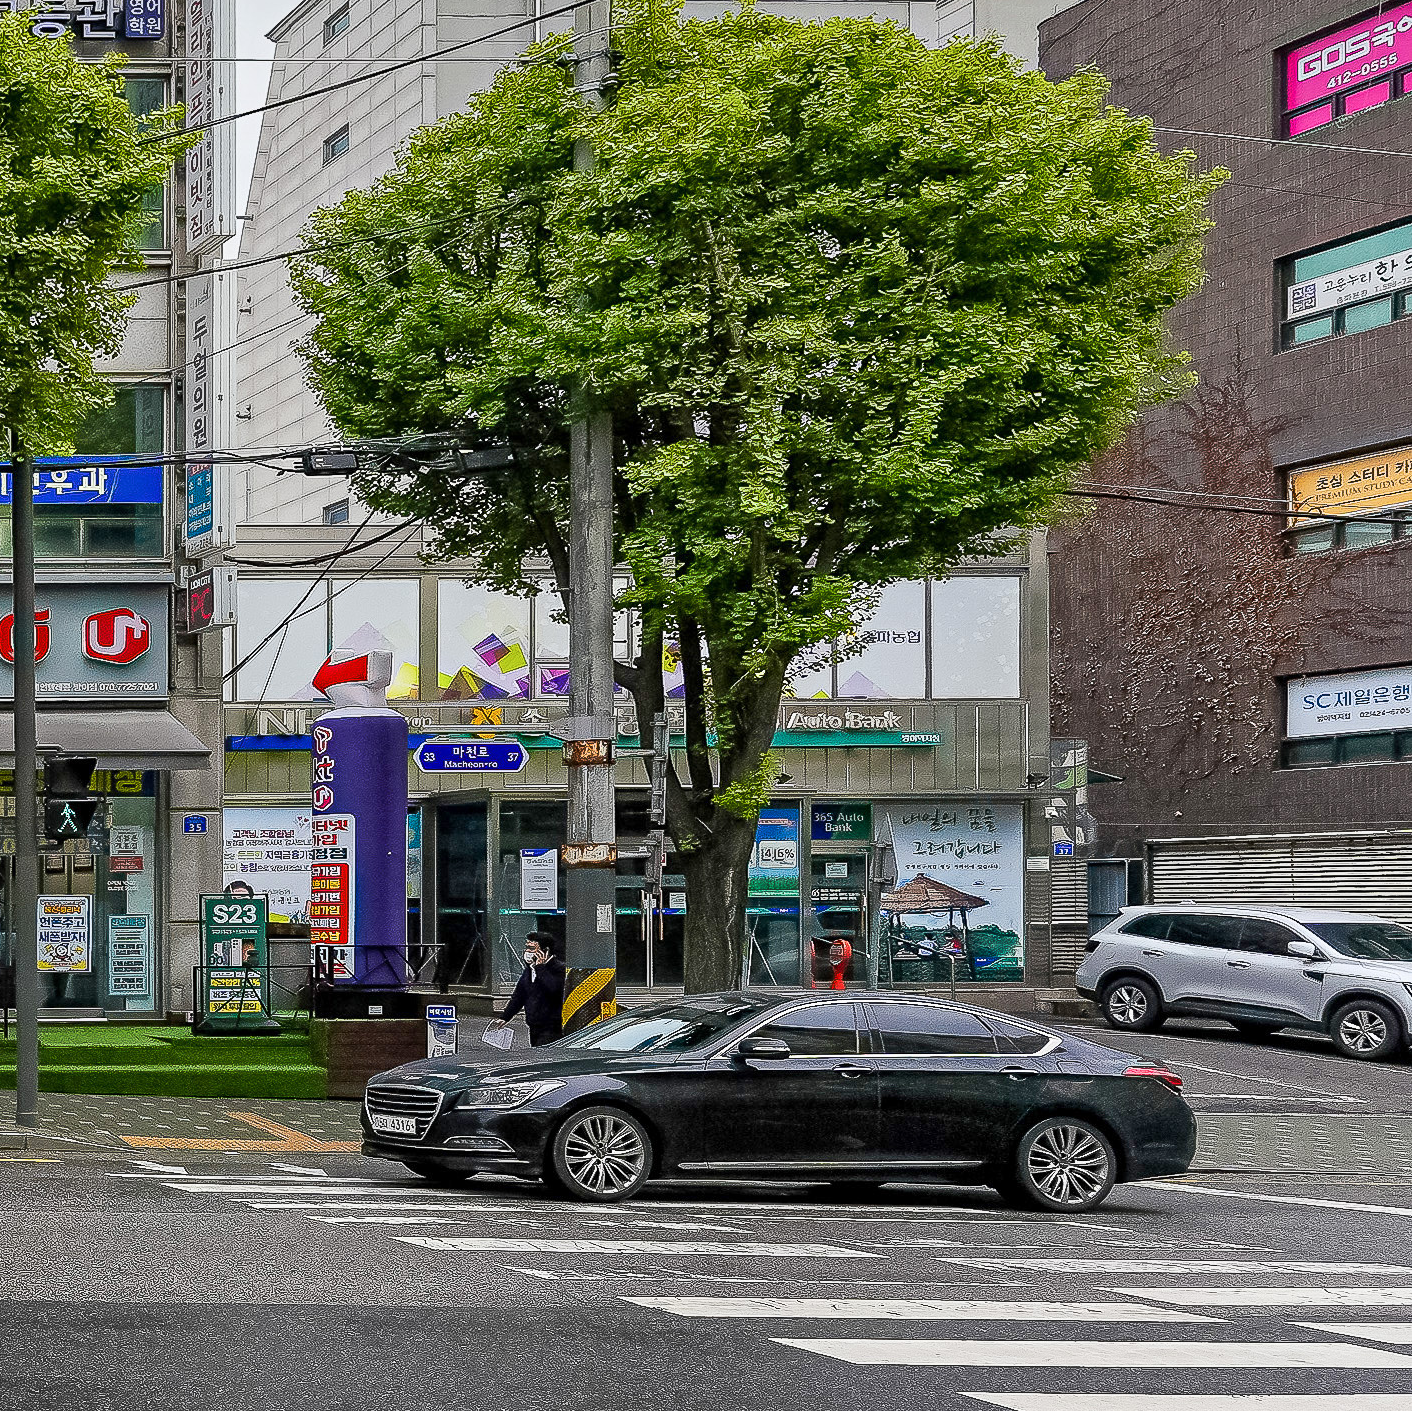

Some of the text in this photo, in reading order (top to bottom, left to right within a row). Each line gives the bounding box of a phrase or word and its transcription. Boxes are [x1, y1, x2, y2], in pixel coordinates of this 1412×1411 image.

[129, 17, 161, 34] 학원
[1326, 52, 1400, 88] 412-0555
[1316, 466, 1390, 491] 초심 스터디
[1303, 685, 1409, 714] SC제일은행
[424, 753, 435, 761] 33
[453, 746, 489, 758] 마천로
[508, 753, 518, 761] 37
[815, 813, 861, 821] 365 Auto
[825, 823, 852, 831] Bank
[213, 905, 256, 923] S23
